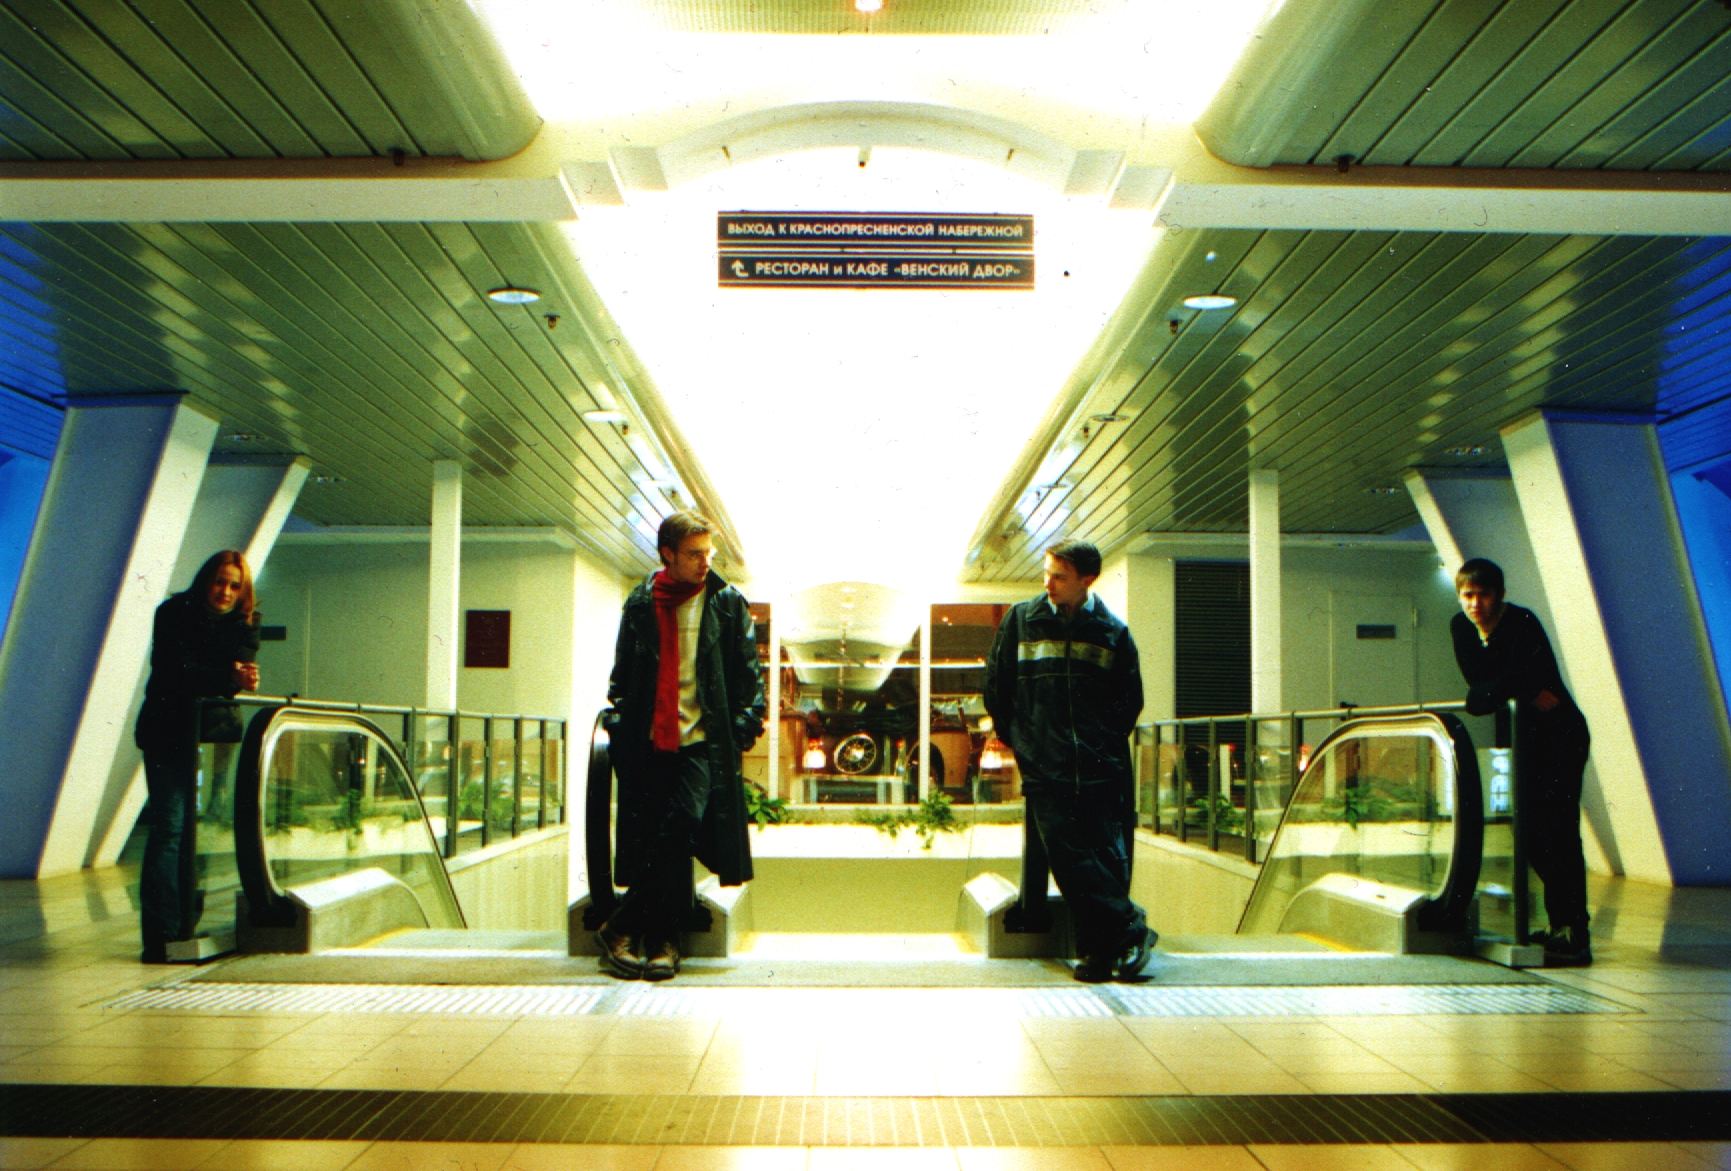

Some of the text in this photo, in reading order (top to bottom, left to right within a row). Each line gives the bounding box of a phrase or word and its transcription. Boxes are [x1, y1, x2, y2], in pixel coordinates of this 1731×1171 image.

[727, 222, 1023, 237] ВЫХОД К КРАСНОПРЕСНЕНСКОЙ НАБЕРЕЖНОЙ
[755, 261, 829, 275] РЕСТОРАН
[846, 262, 889, 276] КАФЕ
